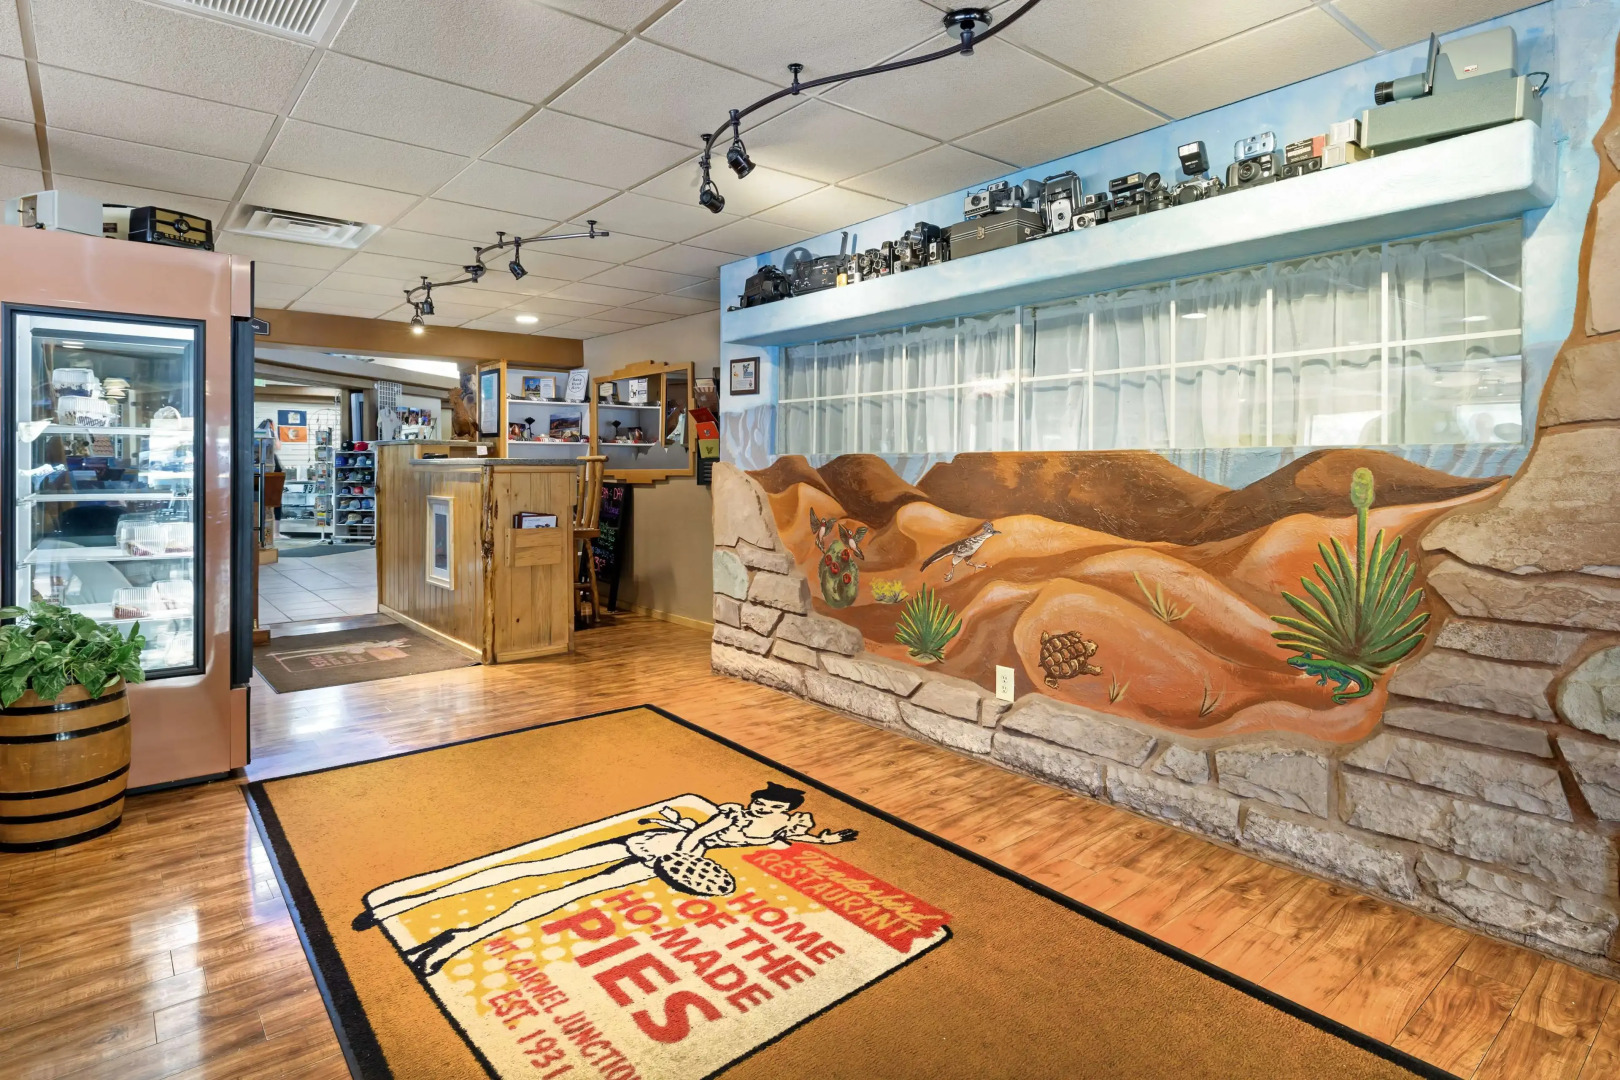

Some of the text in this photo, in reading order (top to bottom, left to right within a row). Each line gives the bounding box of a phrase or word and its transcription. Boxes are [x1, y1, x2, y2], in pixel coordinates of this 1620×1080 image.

[728, 891, 845, 965] HOME
[754, 853, 921, 938] RESTAURANT
[794, 850, 944, 926] Thunderbird
[540, 907, 724, 1045] PIES
[602, 889, 773, 1014] HO-MADE
[677, 900, 817, 990] OF THE
[483, 936, 641, 1080] MT. CARMEL JUNCTIO
[488, 989, 574, 1080] EST. 1931
